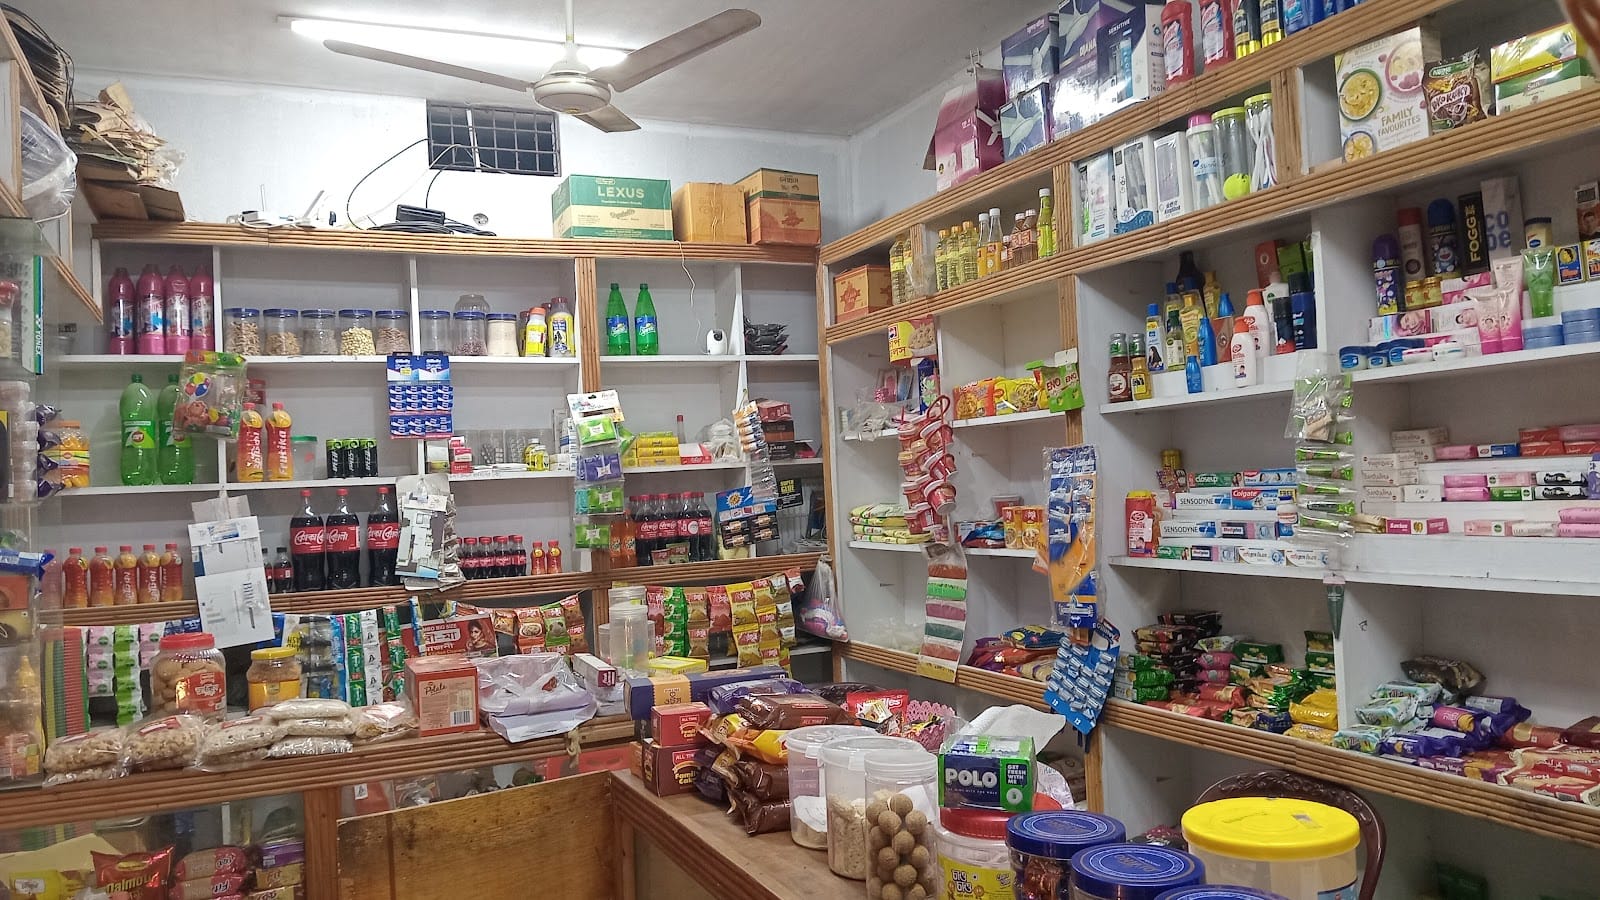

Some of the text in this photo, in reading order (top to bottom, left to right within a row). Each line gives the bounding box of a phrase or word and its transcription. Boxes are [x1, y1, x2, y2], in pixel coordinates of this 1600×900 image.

[1381, 106, 1414, 127] FAMILY
[1378, 114, 1421, 136] FAVOURITES
[597, 185, 645, 198] LEXUS
[1046, 378, 1061, 391] ENO
[279, 430, 287, 475] Frutika
[1195, 474, 1218, 483] closeup
[1232, 490, 1258, 500] Colgate
[675, 770, 696, 780] Famil
[945, 768, 998, 789] POLO
